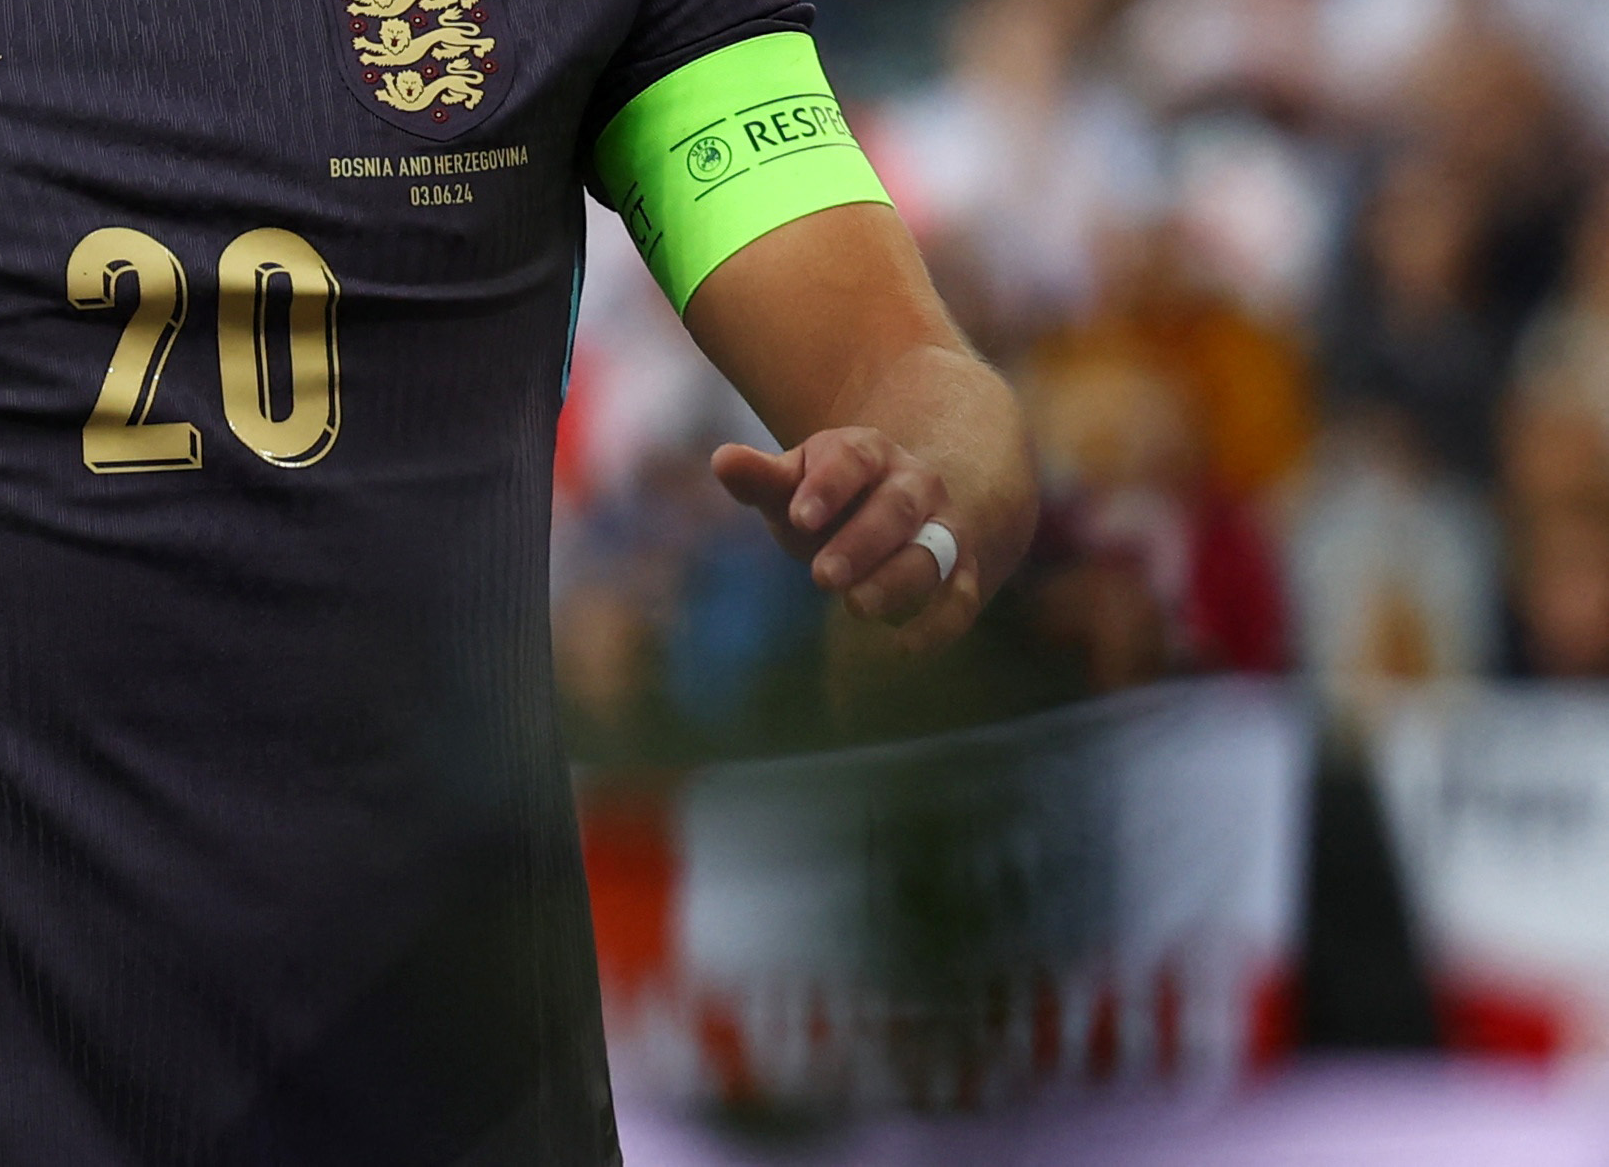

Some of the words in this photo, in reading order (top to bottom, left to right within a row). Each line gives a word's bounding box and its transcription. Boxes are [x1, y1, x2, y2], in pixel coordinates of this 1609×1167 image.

[329, 157, 394, 178] BOSNIA
[398, 156, 431, 177] AND
[434, 145, 529, 176] HERZEGOVINA
[410, 183, 473, 206] 03.06.24
[66, 226, 341, 474] 20
